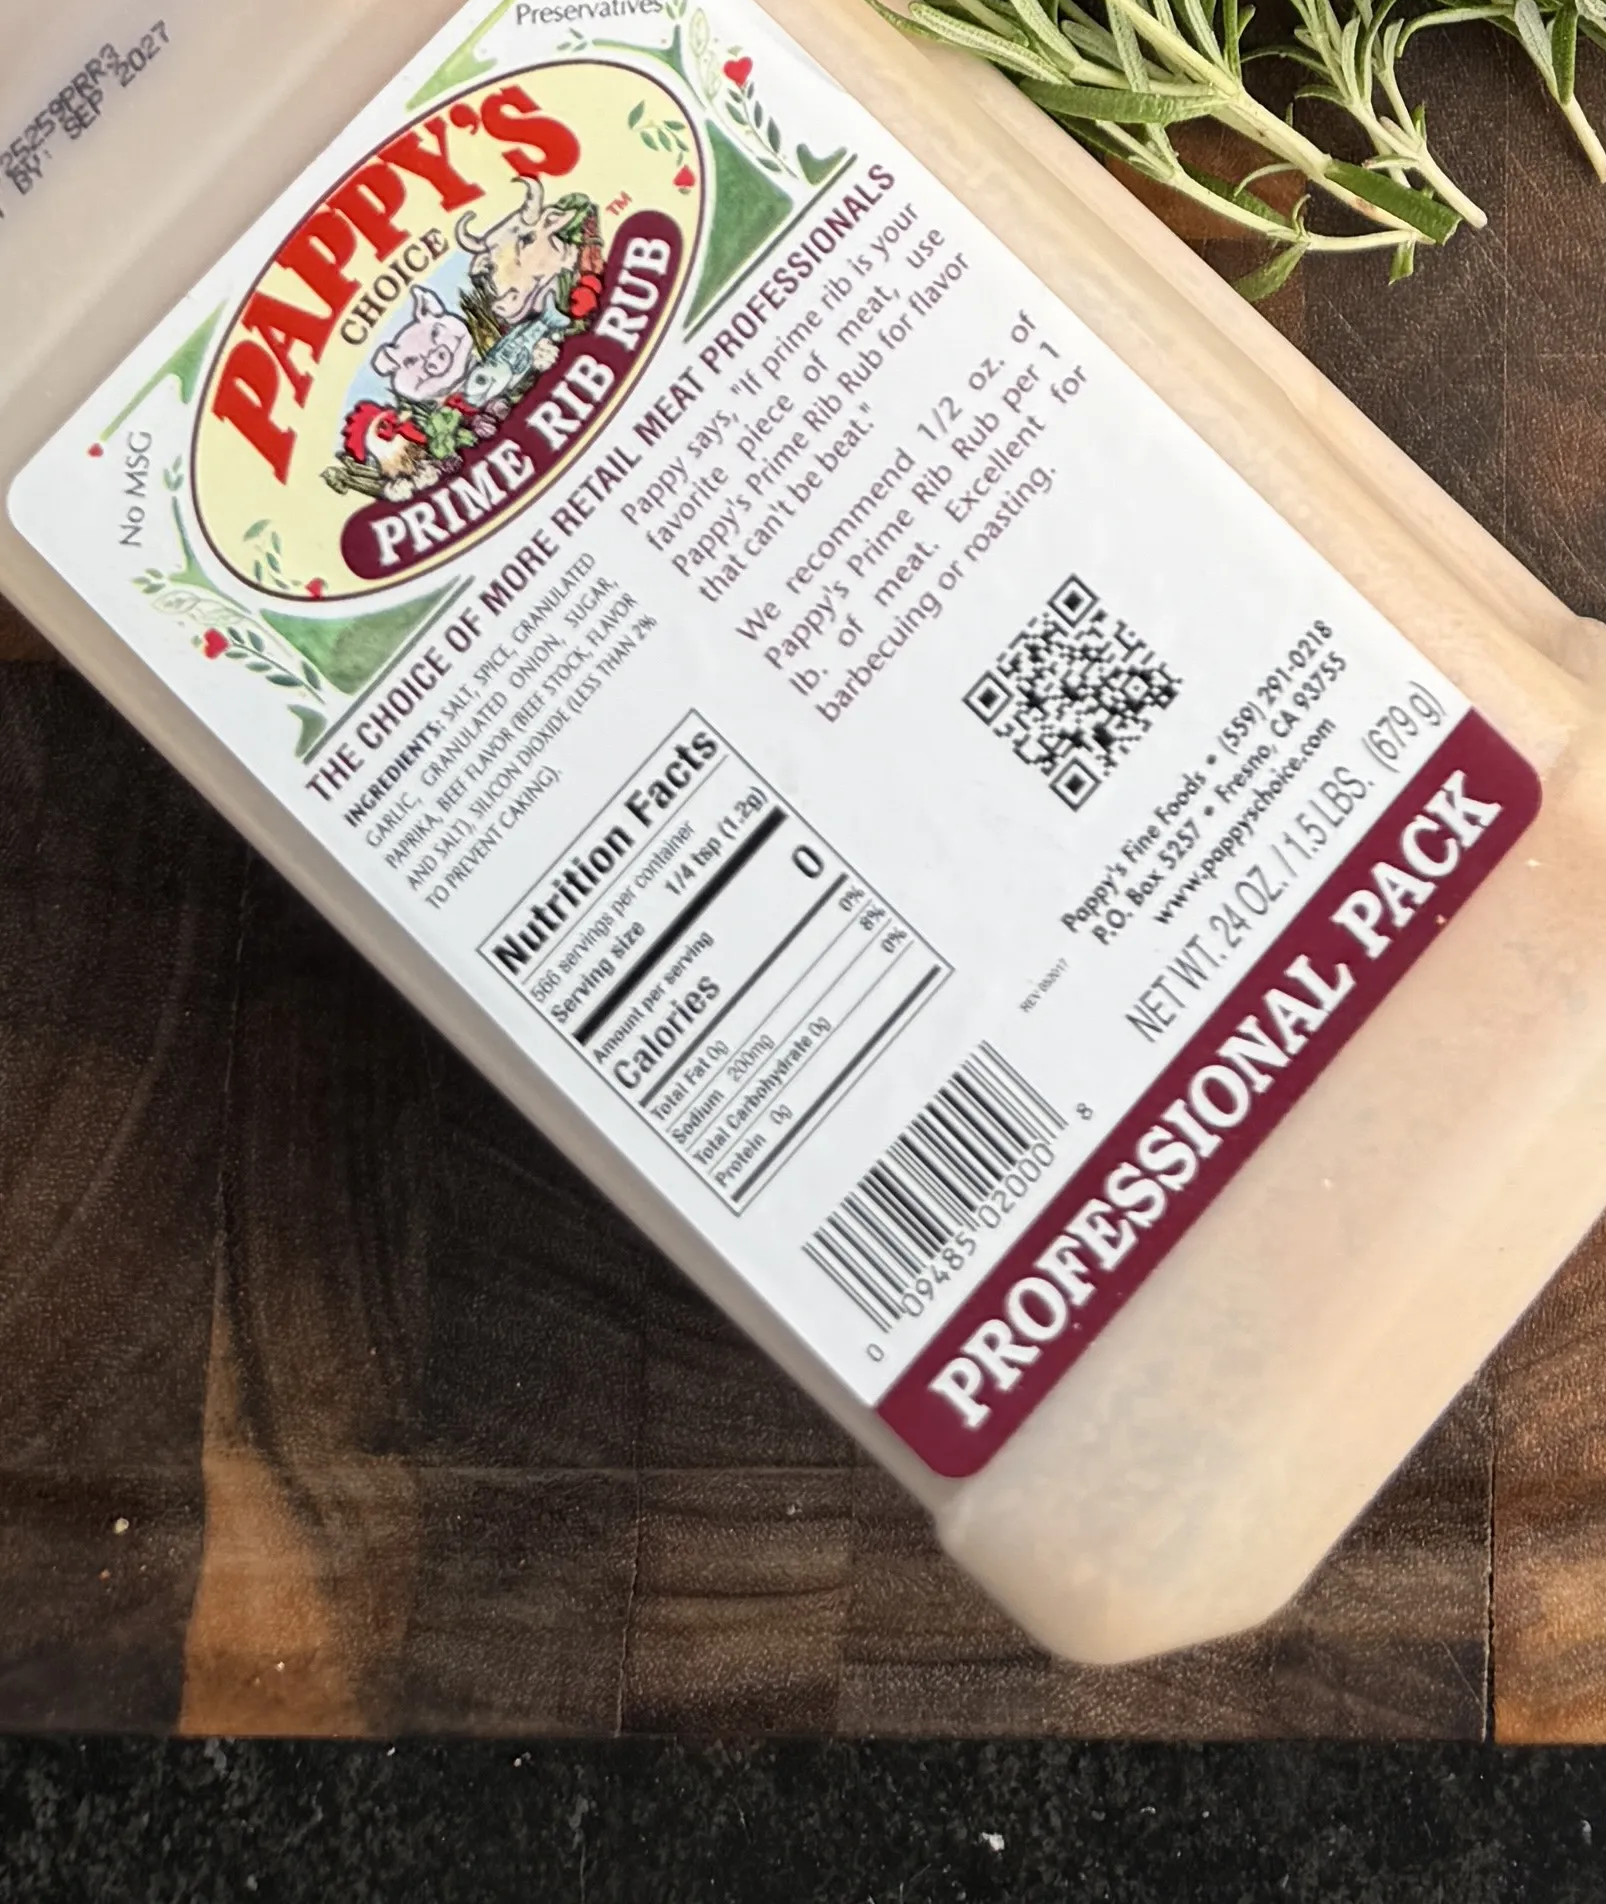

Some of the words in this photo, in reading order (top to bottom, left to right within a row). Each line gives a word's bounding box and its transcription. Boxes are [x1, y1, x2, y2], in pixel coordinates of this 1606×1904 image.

[63, 89, 104, 140] SEP
[115, 19, 169, 87] 2027
[212, 85, 580, 485] PAPPY'S
[340, 228, 449, 345] CHOICE
[607, 191, 633, 217] TM
[124, 431, 152, 497] MSG
[304, 741, 365, 802] THE
[355, 645, 453, 751] CHOICE
[443, 606, 482, 654] OF
[477, 528, 561, 618] MORE
[549, 445, 643, 538] RETAIL
[631, 365, 705, 448] MEAT
[697, 163, 896, 376] PROFESSIONALS
[371, 439, 536, 567] PRIME
[527, 354, 615, 451] RIB
[595, 237, 671, 351] RUB
[619, 455, 690, 527] Pappy
[685, 409, 740, 460] says,
[729, 367, 764, 397] "If
[760, 309, 824, 382] prime
[819, 276, 854, 312] rib
[845, 253, 875, 278] is
[868, 202, 919, 264] your
[645, 466, 730, 553] favorite
[735, 393, 795, 463] piece
[802, 348, 829, 385] of
[835, 285, 901, 347] meat,
[905, 228, 946, 270] use
[670, 493, 753, 578] Pappy's
[744, 430, 810, 497] Prime
[801, 393, 844, 434] Rib
[835, 348, 884, 396] Rub
[877, 312, 914, 351] for
[907, 251, 970, 318] flavor
[734, 601, 782, 642] We
[784, 446, 917, 596] recommend
[915, 395, 964, 442] 1/2
[967, 357, 1006, 392] oz.
[1010, 308, 1038, 345] of
[118, 506, 145, 547] No
[698, 553, 748, 604] that
[743, 499, 797, 558] can't
[785, 470, 824, 505] be
[813, 401, 875, 474] beat."
[762, 579, 851, 671] Pappy's
[844, 508, 915, 579] Prime
[910, 463, 954, 506] Rib
[950, 411, 1000, 462] Rub
[1001, 363, 1041, 415] per
[1038, 340, 1061, 360] 1
[787, 667, 829, 698] lb.
[837, 612, 865, 649] of
[873, 541, 941, 608] meat.
[942, 414, 1046, 525] Excellent
[1049, 364, 1088, 405] for
[814, 590, 944, 724] barbecuing
[937, 559, 965, 592] or
[962, 466, 1057, 563] roasting.
[343, 722, 446, 829] INGREDIENTS:
[439, 683, 482, 723] SALT,
[471, 643, 519, 687] SPICE,
[510, 551, 597, 646] GRANULATED
[364, 791, 423, 849] GARLIC,
[419, 690, 509, 788] GRANULATED
[507, 633, 568, 691] ONION,
[562, 576, 620, 629] SUGAR,
[1059, 862, 1129, 934] Pappy's
[1119, 824, 1162, 865] Fine
[1152, 771, 1207, 827] Foods
[1217, 700, 1268, 756] (559)
[1256, 618, 1334, 707] 291-0218
[1090, 907, 1135, 947] P.O.
[1123, 869, 1166, 908] Box
[1156, 817, 1201, 872] 5257
[1212, 744, 1279, 805] Fresno,
[1269, 709, 1302, 739] CA
[1291, 650, 1347, 712] 93755
[1308, 765, 1376, 830] LBS.
[1360, 704, 1420, 774] (679
[491, 825, 635, 976] Nutrition
[623, 731, 718, 829] Facts
[528, 968, 562, 1004] 566
[556, 911, 616, 976] servings
[609, 885, 638, 919] per
[633, 820, 696, 890] container
[549, 957, 617, 1025] Serving
[609, 920, 646, 961] size
[664, 862, 697, 896] 1/4
[689, 836, 723, 868] tsp
[717, 785, 769, 841] (1.2g)
[1152, 717, 1337, 926] www.pappyschoice.com
[1208, 902, 1253, 950] 24
[1233, 863, 1290, 917] OZ.
[1269, 843, 1299, 879] /
[1281, 811, 1329, 861] 1.5
[612, 975, 721, 1090] Calories
[790, 844, 825, 880] 0
[648, 1081, 690, 1122] Total
[682, 1056, 712, 1087] Fat
[704, 1038, 730, 1062] 0g
[837, 885, 866, 914] 0%
[670, 1088, 726, 1146] Sodium
[726, 1033, 776, 1083] 200mg
[858, 905, 887, 932] 8%
[691, 1125, 732, 1166] Total
[725, 1034, 814, 1131] Carbohydrate
[879, 928, 908, 955] 0%
[1123, 974, 1186, 1044] NET
[1165, 932, 1228, 992] WT.
[713, 1133, 768, 1189] Protein
[927, 953, 1357, 1430] PROFESSIONAL
[1330, 768, 1504, 960] PACK
[865, 1342, 886, 1364] 0
[1074, 1102, 1095, 1122] 8
